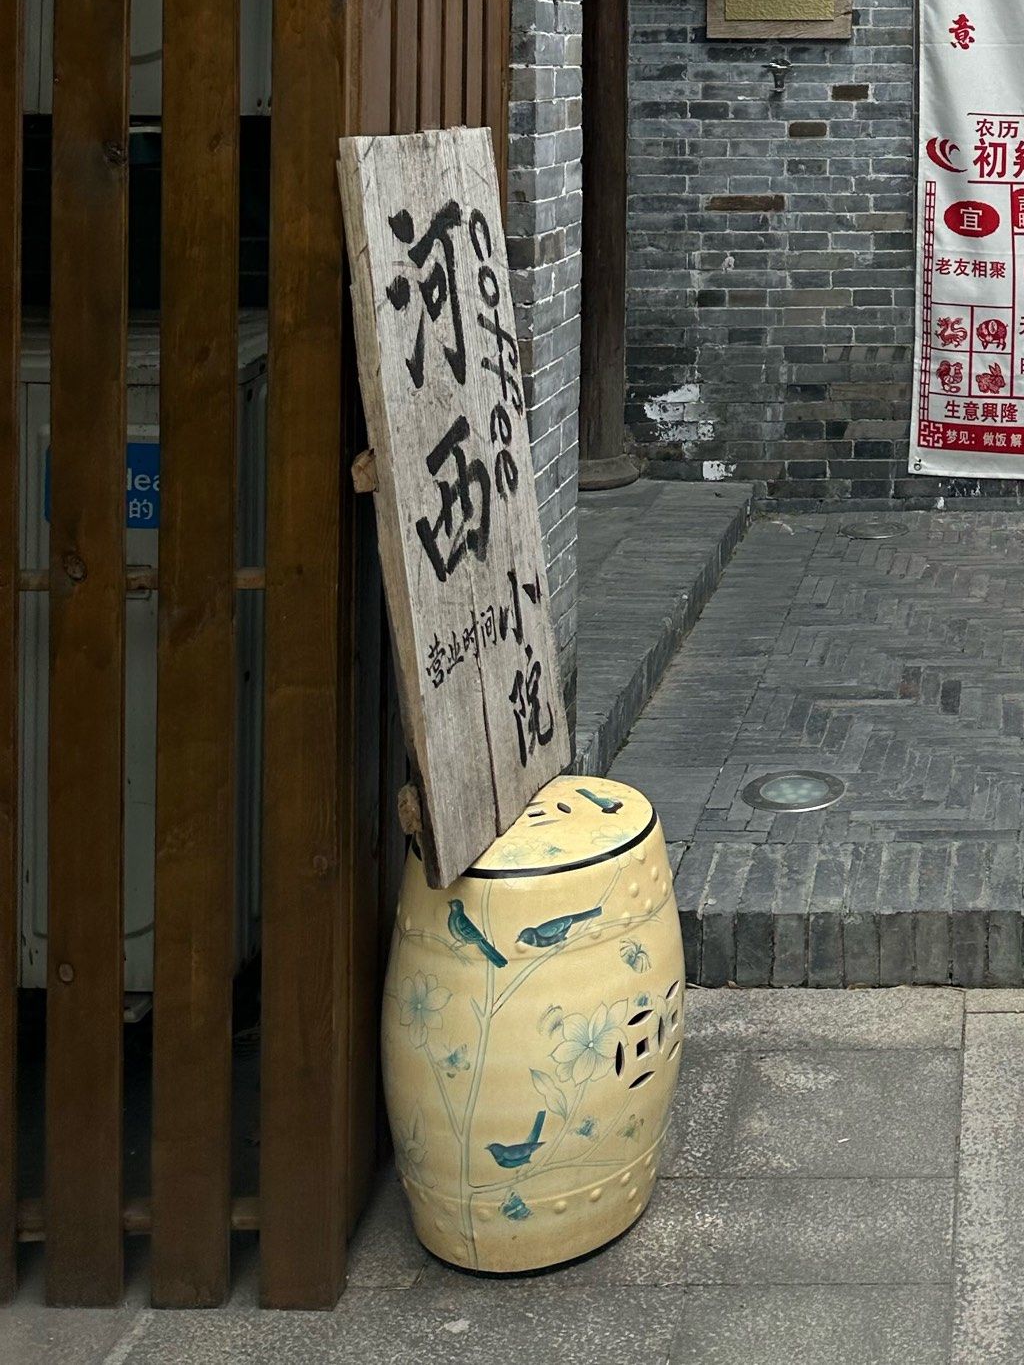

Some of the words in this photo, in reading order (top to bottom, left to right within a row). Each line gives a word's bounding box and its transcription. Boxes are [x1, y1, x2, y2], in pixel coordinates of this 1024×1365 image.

[960, 208, 982, 230] 宜
[935, 258, 1006, 278] 老友相聚
[468, 208, 526, 498] coffee
[386, 199, 491, 582] 河西
[945, 401, 1018, 423] 生意興隆
[130, 499, 153, 519] 的
[427, 605, 499, 688] 营业时间
[499, 570, 554, 768] 小院
